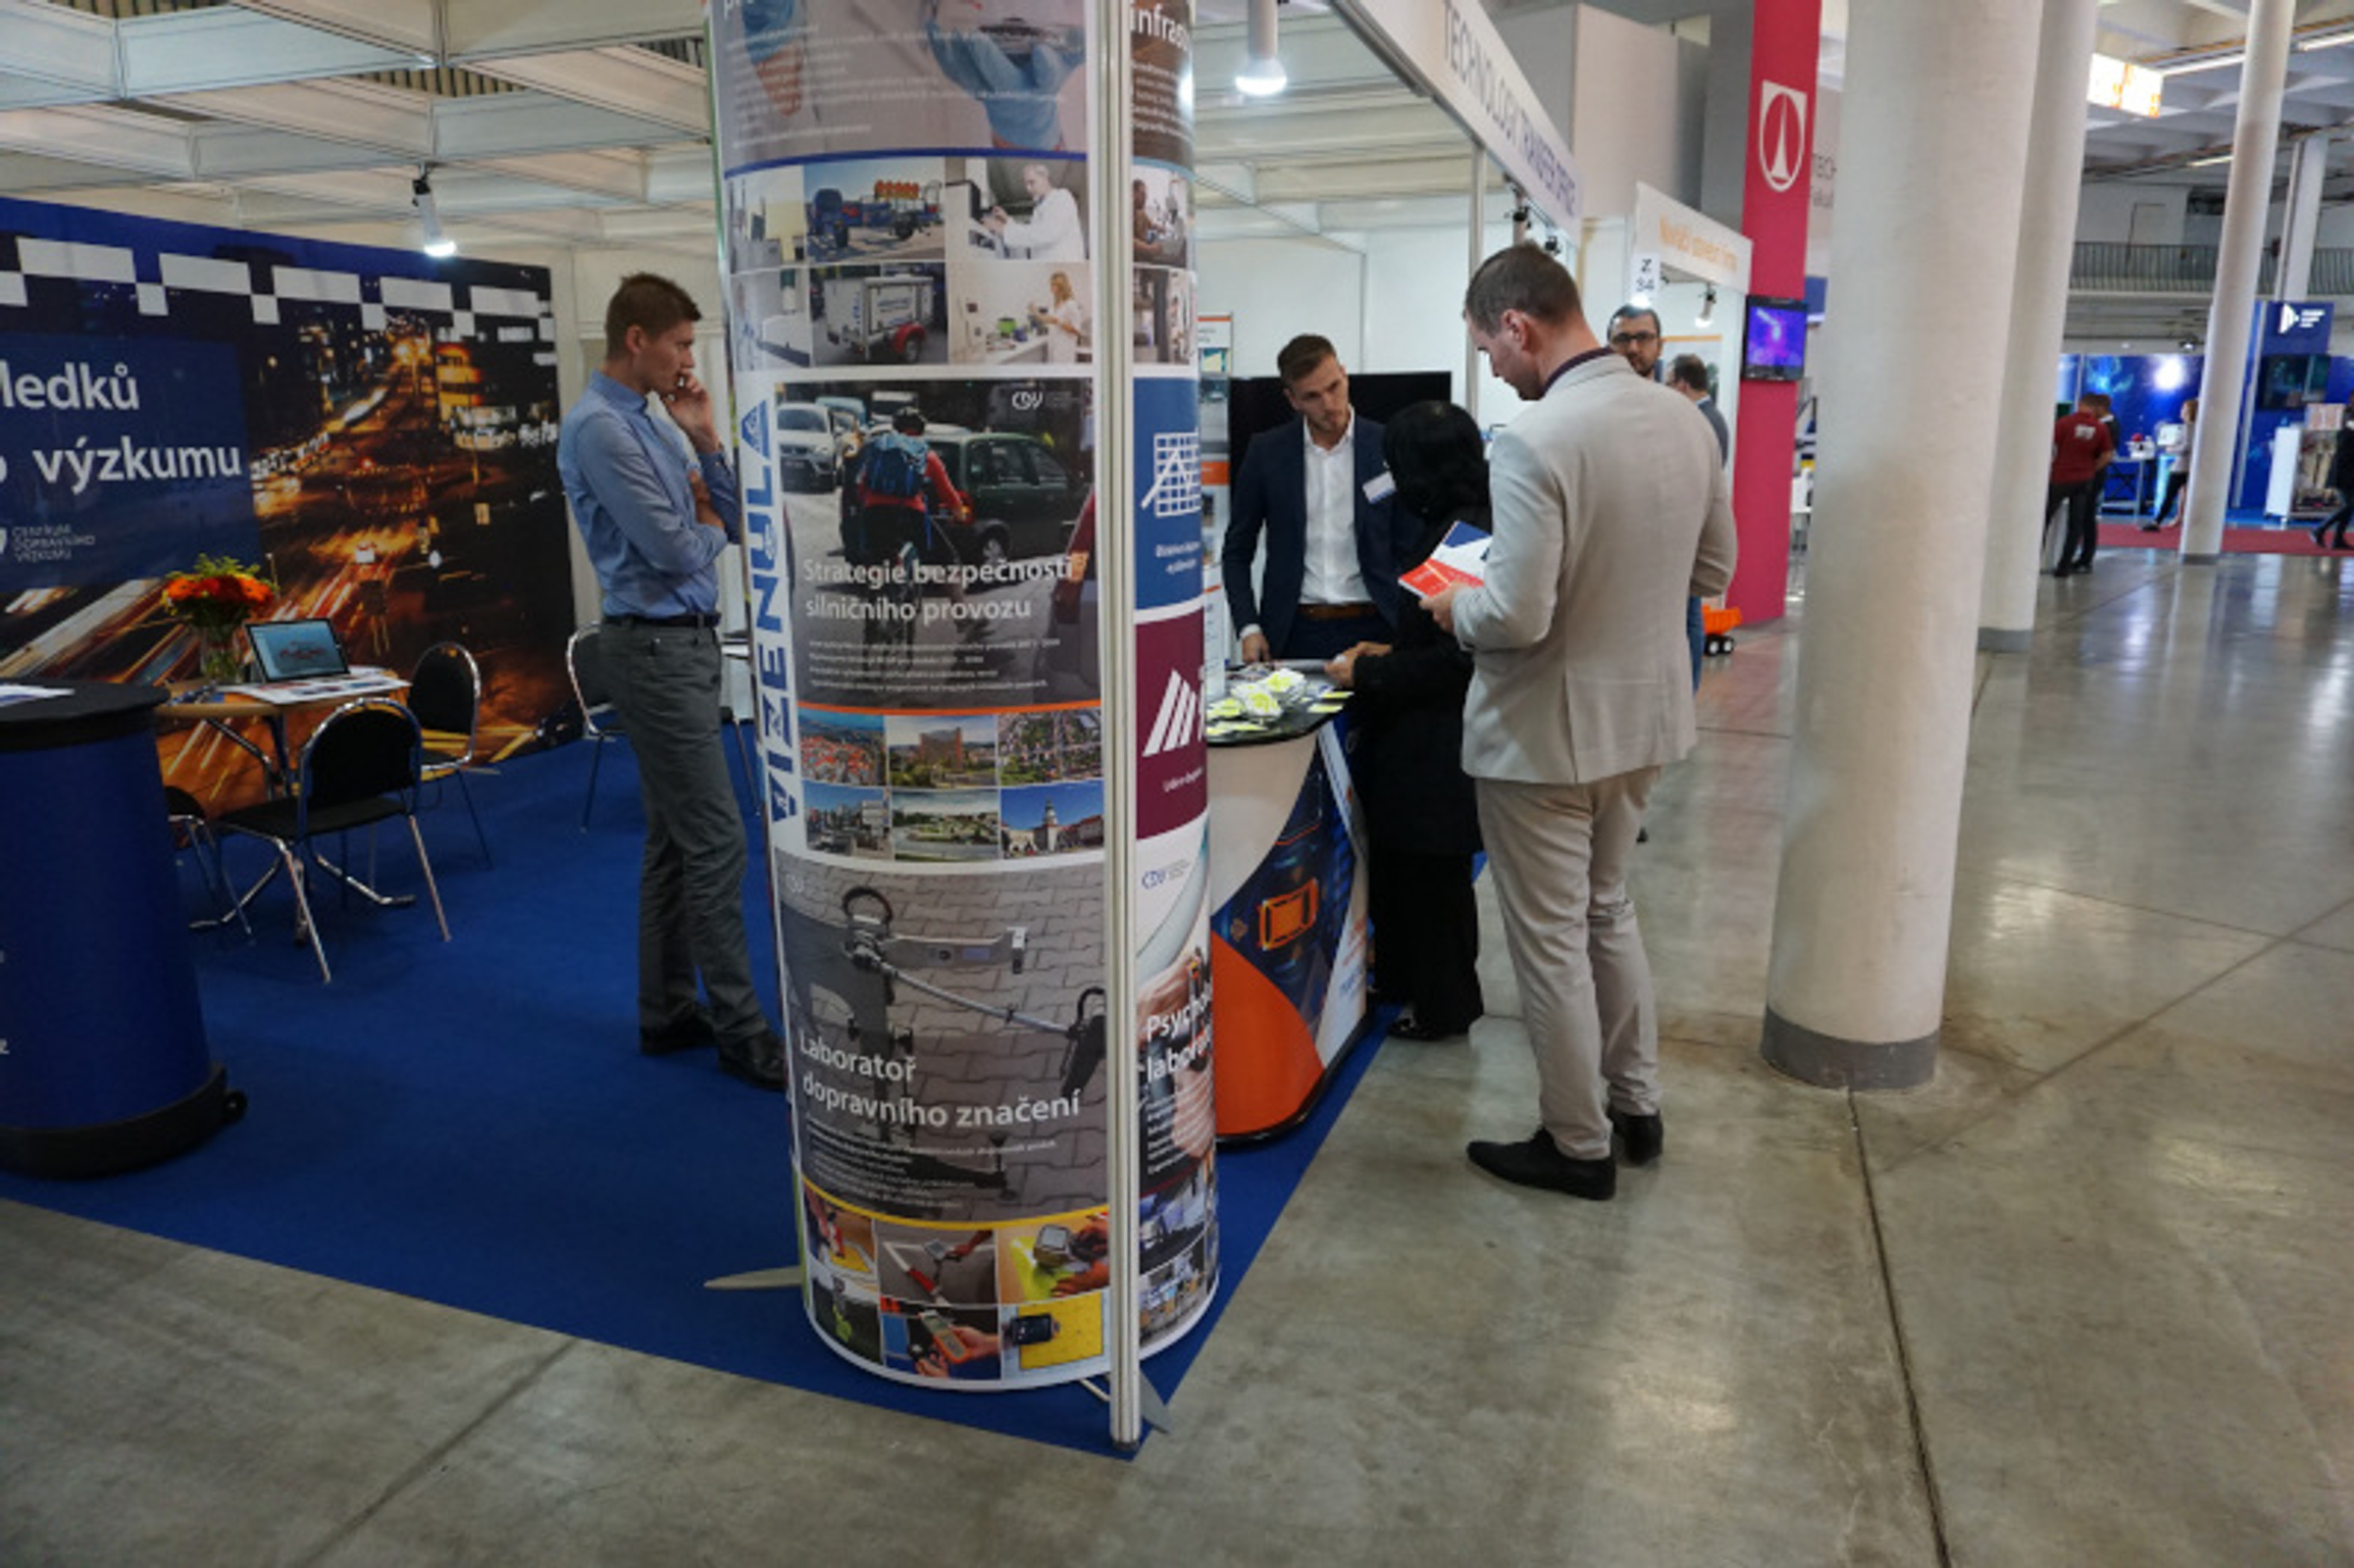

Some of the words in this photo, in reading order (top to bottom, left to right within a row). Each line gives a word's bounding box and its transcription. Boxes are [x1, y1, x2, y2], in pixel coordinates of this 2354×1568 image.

[31, 434, 242, 495] výzkumu
[802, 558, 905, 590] Strategie
[911, 555, 1073, 590] bezpečnosti
[922, 599, 1031, 628] provozu
[798, 1028, 917, 1083] Laboratoř
[955, 1089, 1081, 1129] značení
